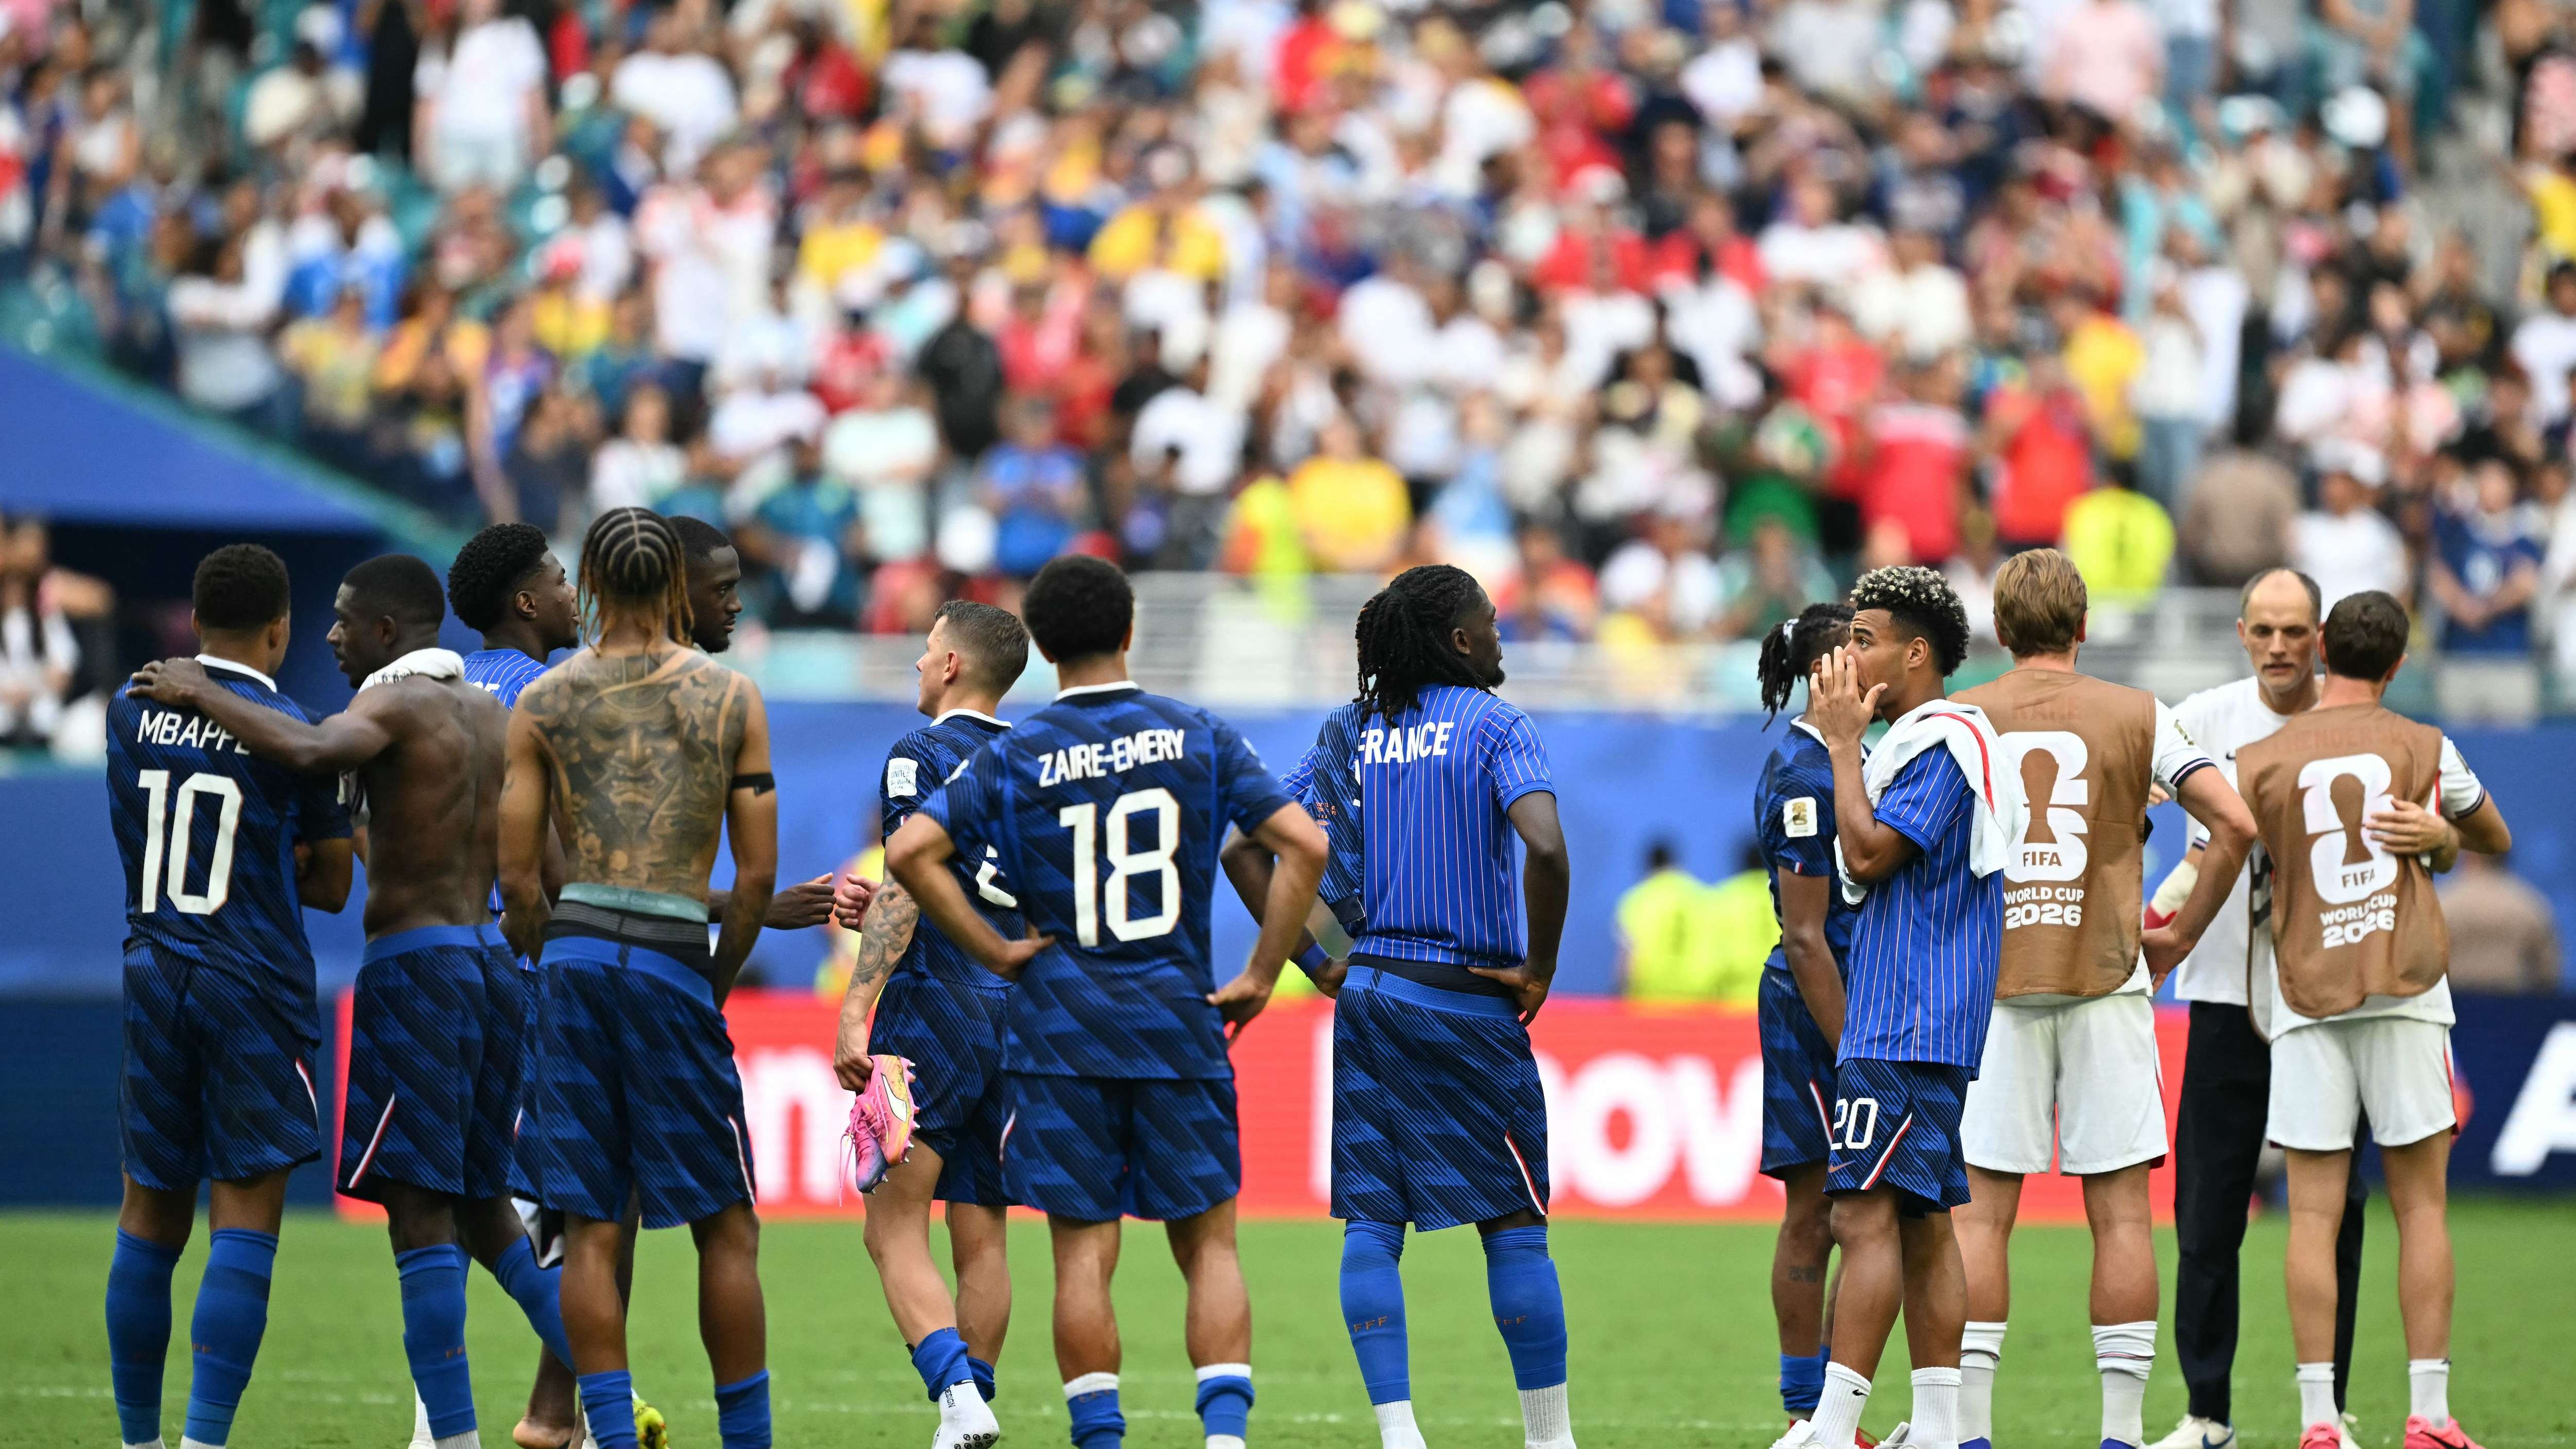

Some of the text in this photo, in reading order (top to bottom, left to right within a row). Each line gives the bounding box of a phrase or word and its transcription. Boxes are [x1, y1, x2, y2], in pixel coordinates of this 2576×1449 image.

[1038, 729, 1184, 788] ZAIRE-EMERY
[137, 770, 242, 915] 10
[2023, 851, 2062, 867] FIFA
[1059, 788, 1182, 948] 18
[2342, 868, 2375, 888] FIFA
[2004, 886, 2084, 905] WORLD CUP
[2370, 894, 2397, 910] CUP
[2005, 903, 2082, 930] 2026
[2322, 909, 2396, 949] 2026
[1831, 1097, 1879, 1150] 20
